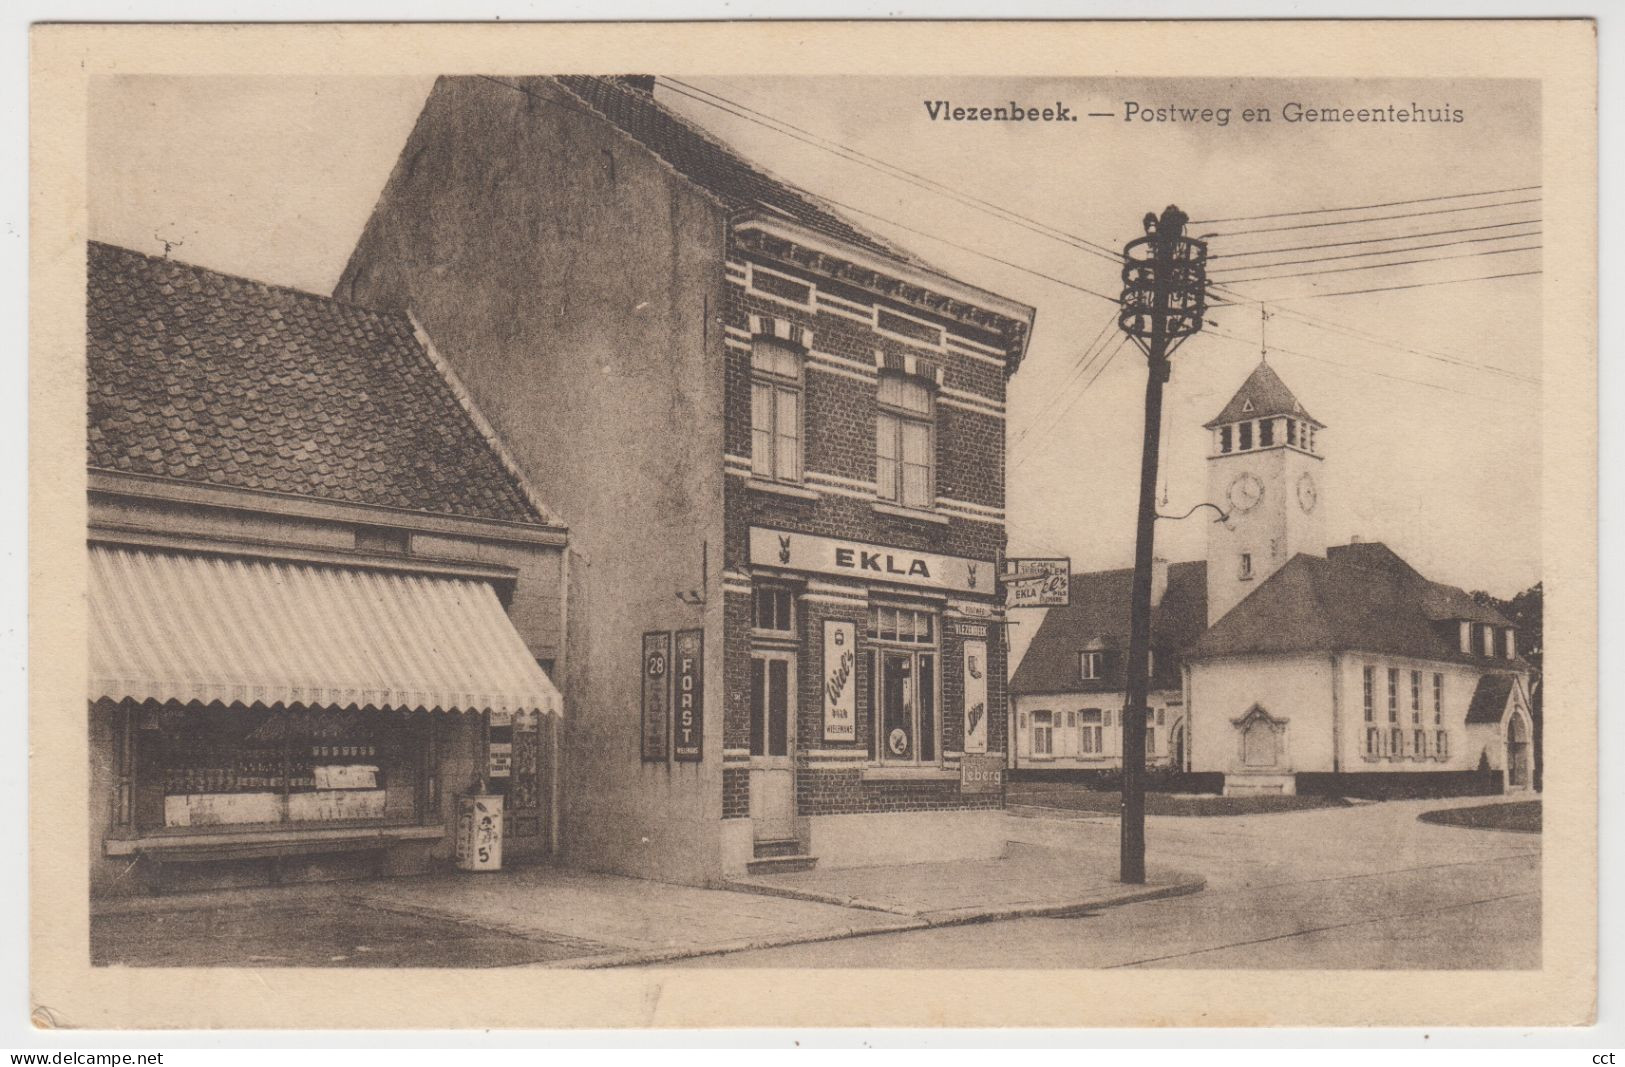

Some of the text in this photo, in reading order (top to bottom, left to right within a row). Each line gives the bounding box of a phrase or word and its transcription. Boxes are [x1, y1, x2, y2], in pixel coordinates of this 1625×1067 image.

[836, 548, 930, 578] EKLA
[1015, 588, 1037, 600] EKLA
[649, 657, 664, 674] 28
[825, 650, 853, 706] Wiel's
[681, 658, 693, 743] FORST
[963, 766, 1001, 786] Leberg
[478, 846, 490, 863] 5
